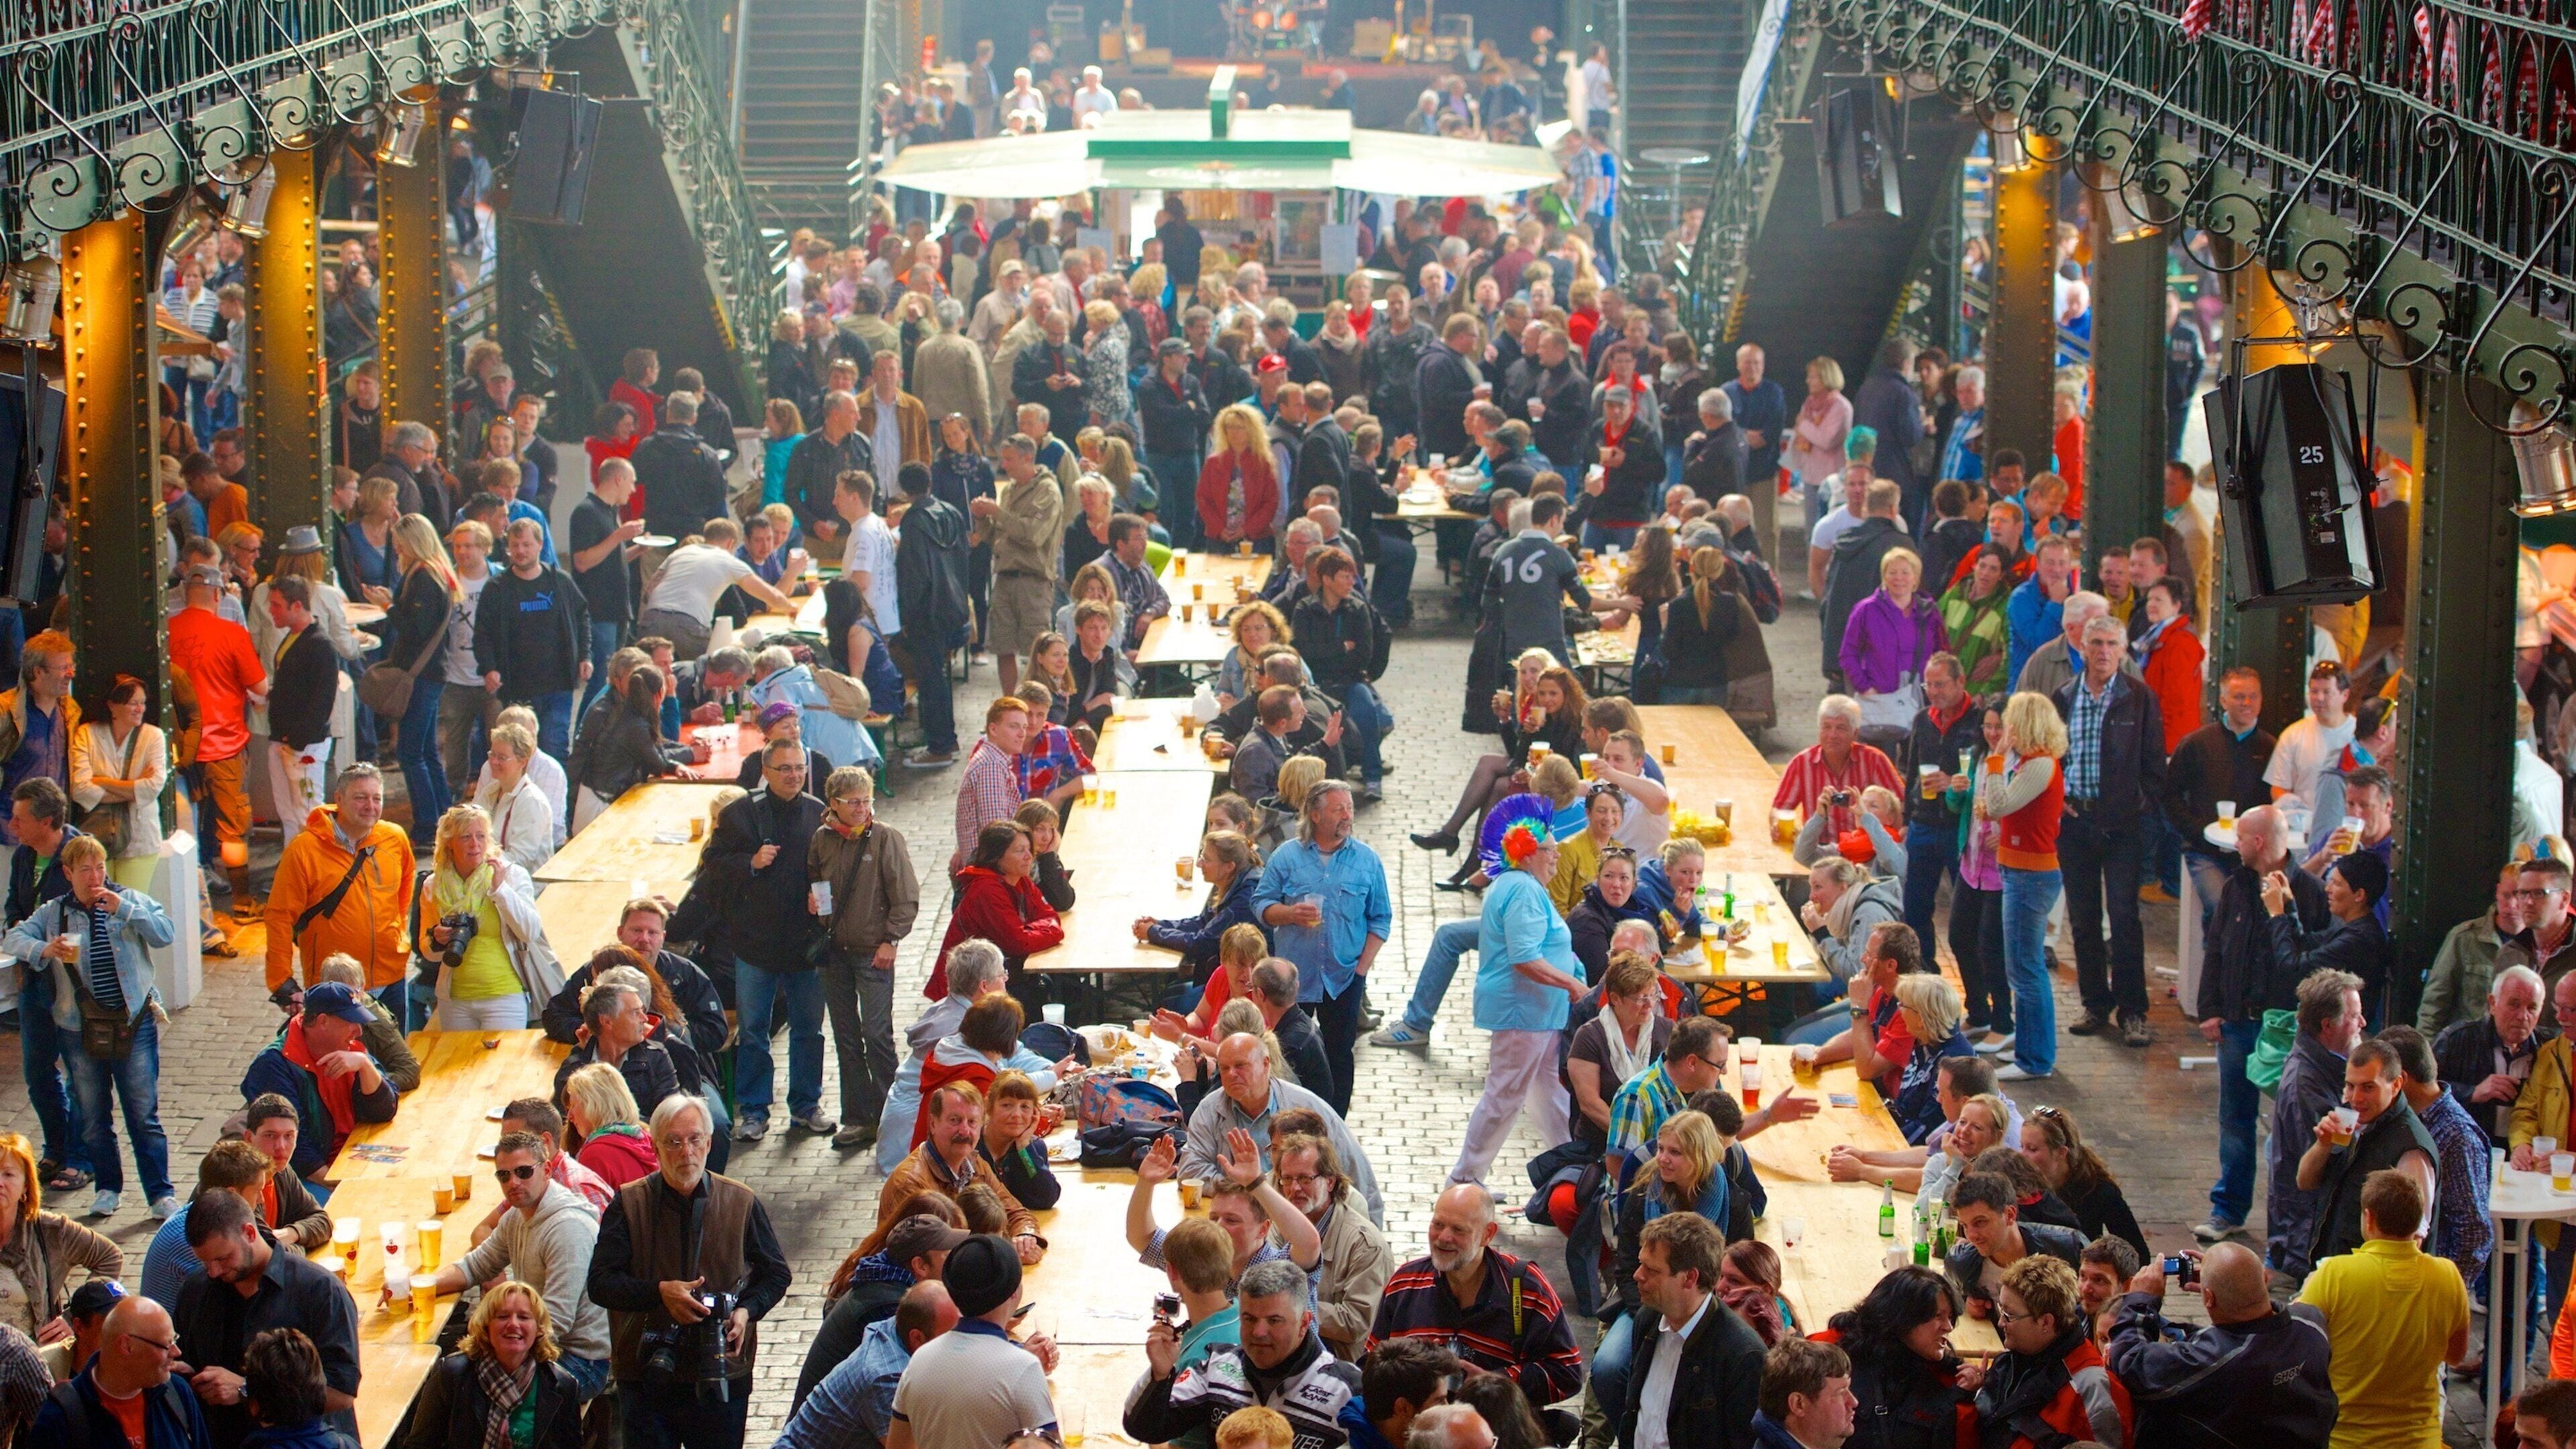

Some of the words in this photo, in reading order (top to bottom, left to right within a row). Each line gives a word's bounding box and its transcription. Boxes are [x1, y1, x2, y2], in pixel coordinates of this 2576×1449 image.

[2300, 445, 2324, 464] 25
[1501, 549, 1547, 584] 16
[1299, 1383, 1335, 1397] FAST
[1301, 1391, 1330, 1405] LANE
